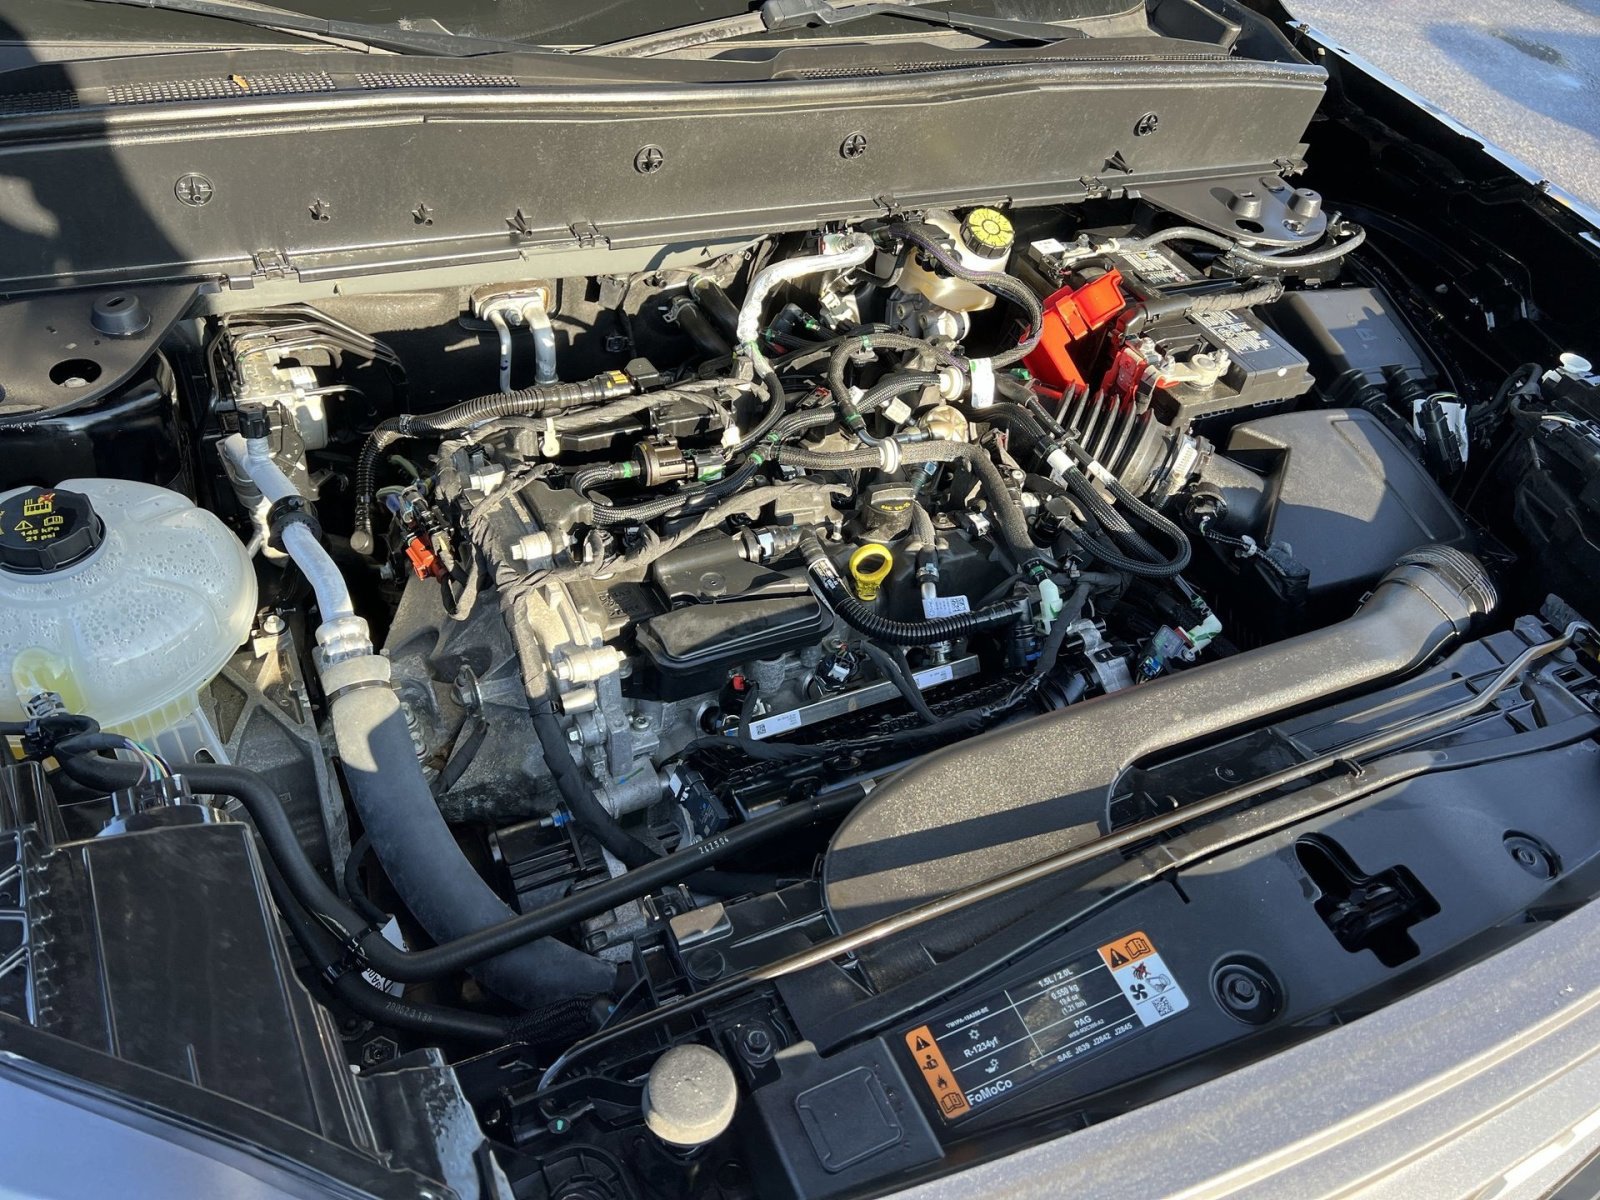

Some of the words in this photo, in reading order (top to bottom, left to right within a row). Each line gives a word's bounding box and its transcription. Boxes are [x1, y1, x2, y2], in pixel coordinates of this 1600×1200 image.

[21, 529, 39, 537] 145
[41, 526, 60, 534] kPa
[1038, 977, 1054, 988] 1.5L
[1056, 968, 1074, 981] 2.0L
[1051, 987, 1068, 1000] 0.550
[1067, 983, 1079, 995] kg
[1074, 1015, 1092, 1028] PAG
[963, 1038, 999, 1058] R-1234yf
[1057, 1051, 1073, 1062] SAE
[1074, 1043, 1090, 1055] J639
[966, 1079, 1013, 1106] FoMoCo
